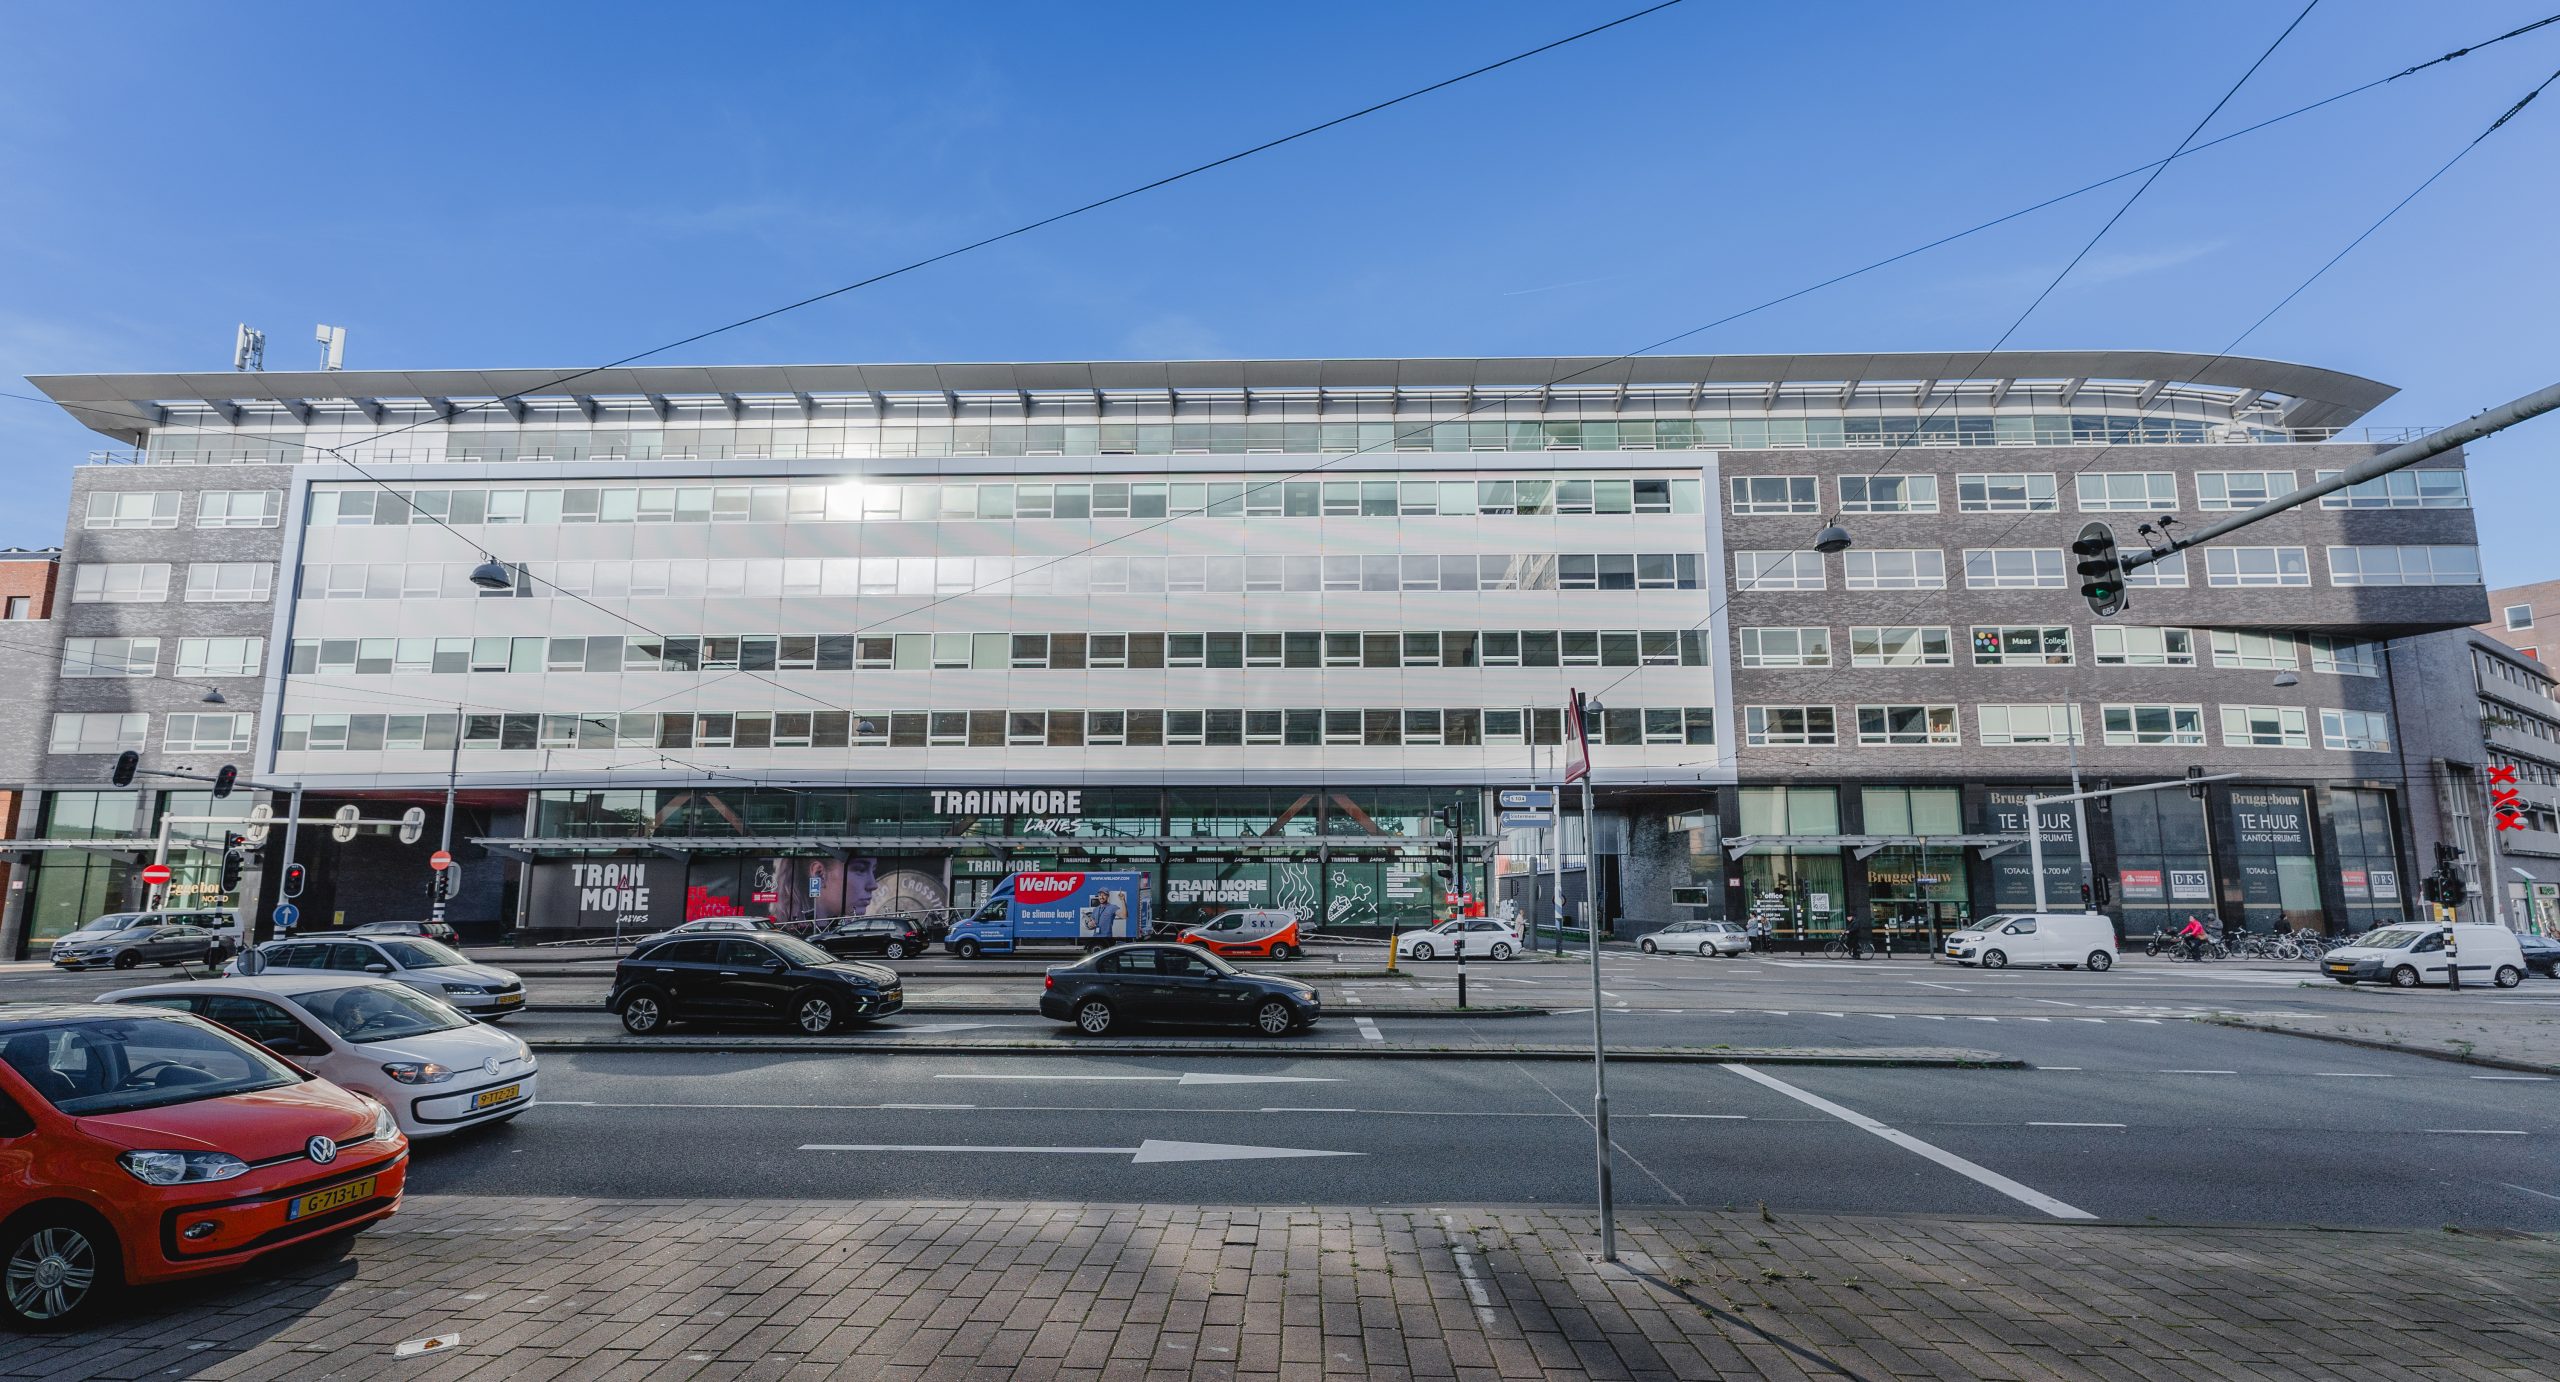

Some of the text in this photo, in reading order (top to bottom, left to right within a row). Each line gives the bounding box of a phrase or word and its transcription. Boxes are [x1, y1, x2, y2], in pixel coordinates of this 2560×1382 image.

[931, 791, 1081, 814] TRAINMORE
[2232, 793, 2300, 807] Bruggebouw
[1023, 818, 1084, 833] LADIES
[1998, 814, 2018, 829] TE
[2239, 814, 2299, 829] TE HUUR
[572, 864, 645, 886] TRAIN
[1020, 877, 1077, 891] Welhof
[1168, 880, 1267, 890] TRAIN MORE
[201, 895, 228, 903] NOOD
[581, 888, 649, 911] MORE
[1167, 891, 1249, 902] GET MORE
[1022, 909, 1074, 920] De slimme koop!
[308, 1182, 368, 1211] G-713-LT
